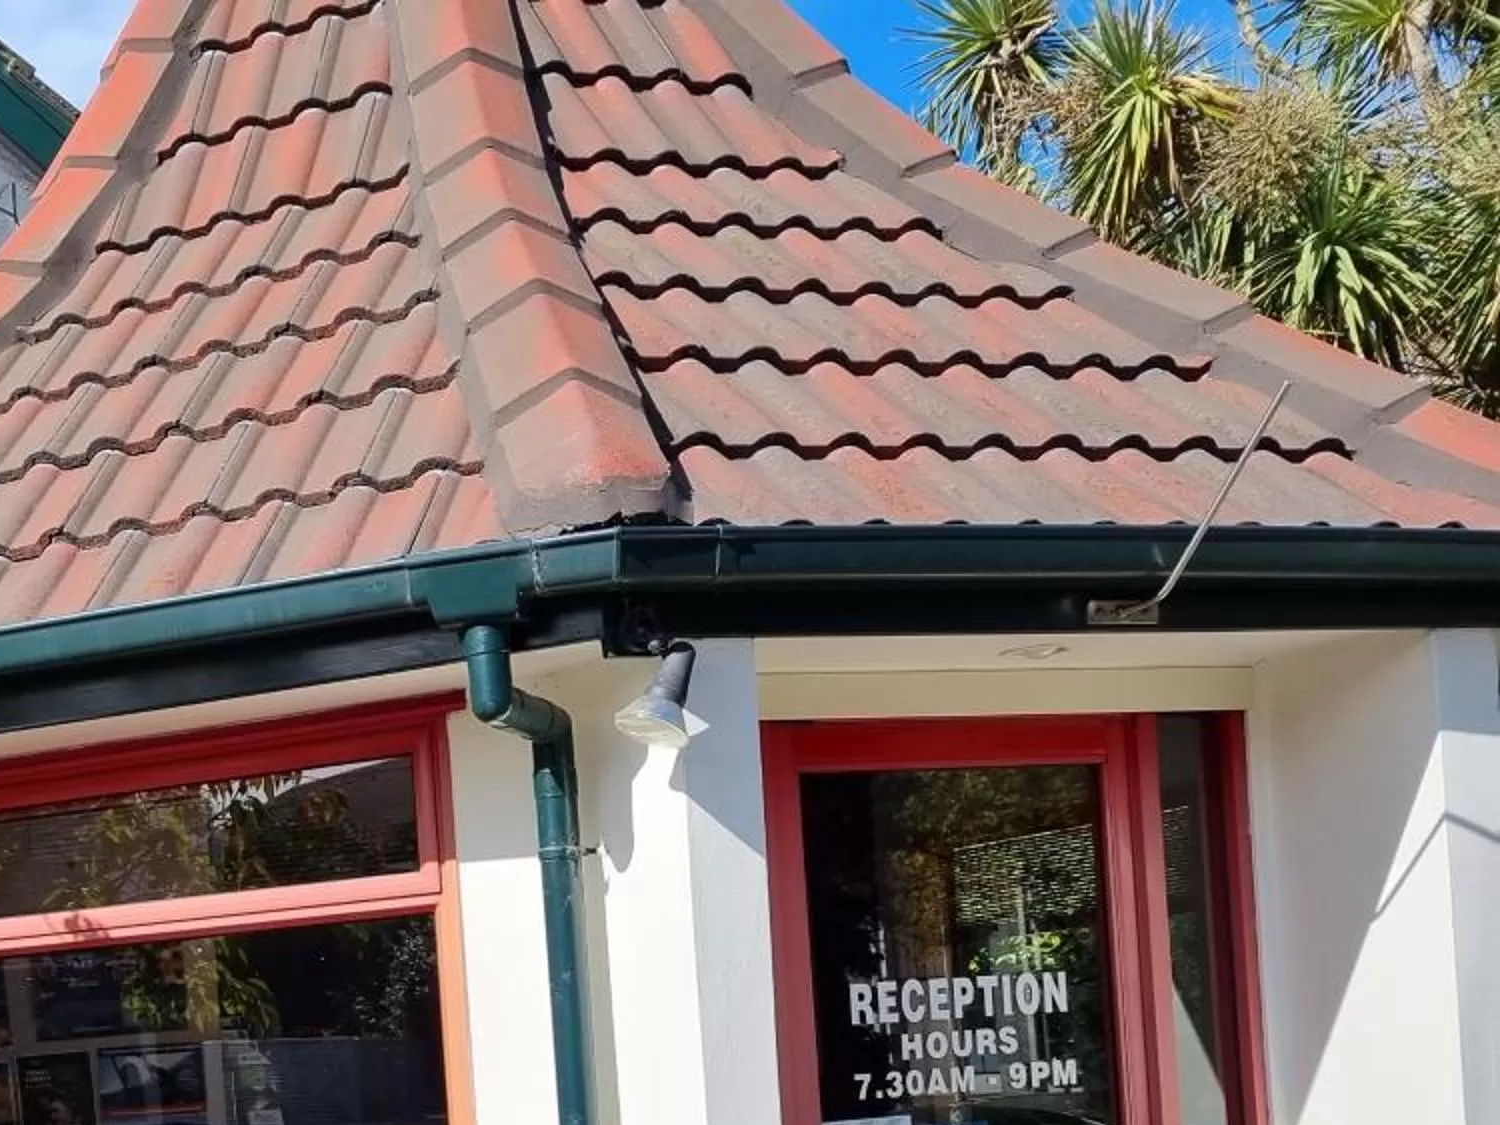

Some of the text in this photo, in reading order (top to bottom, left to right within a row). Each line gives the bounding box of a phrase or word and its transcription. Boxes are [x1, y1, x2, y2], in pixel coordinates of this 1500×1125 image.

[850, 972, 1069, 1026] RECEPTION
[901, 1026, 1019, 1061] HOURS
[853, 1065, 976, 1101] 7.30AM
[1008, 1058, 1077, 1089] 9PM
